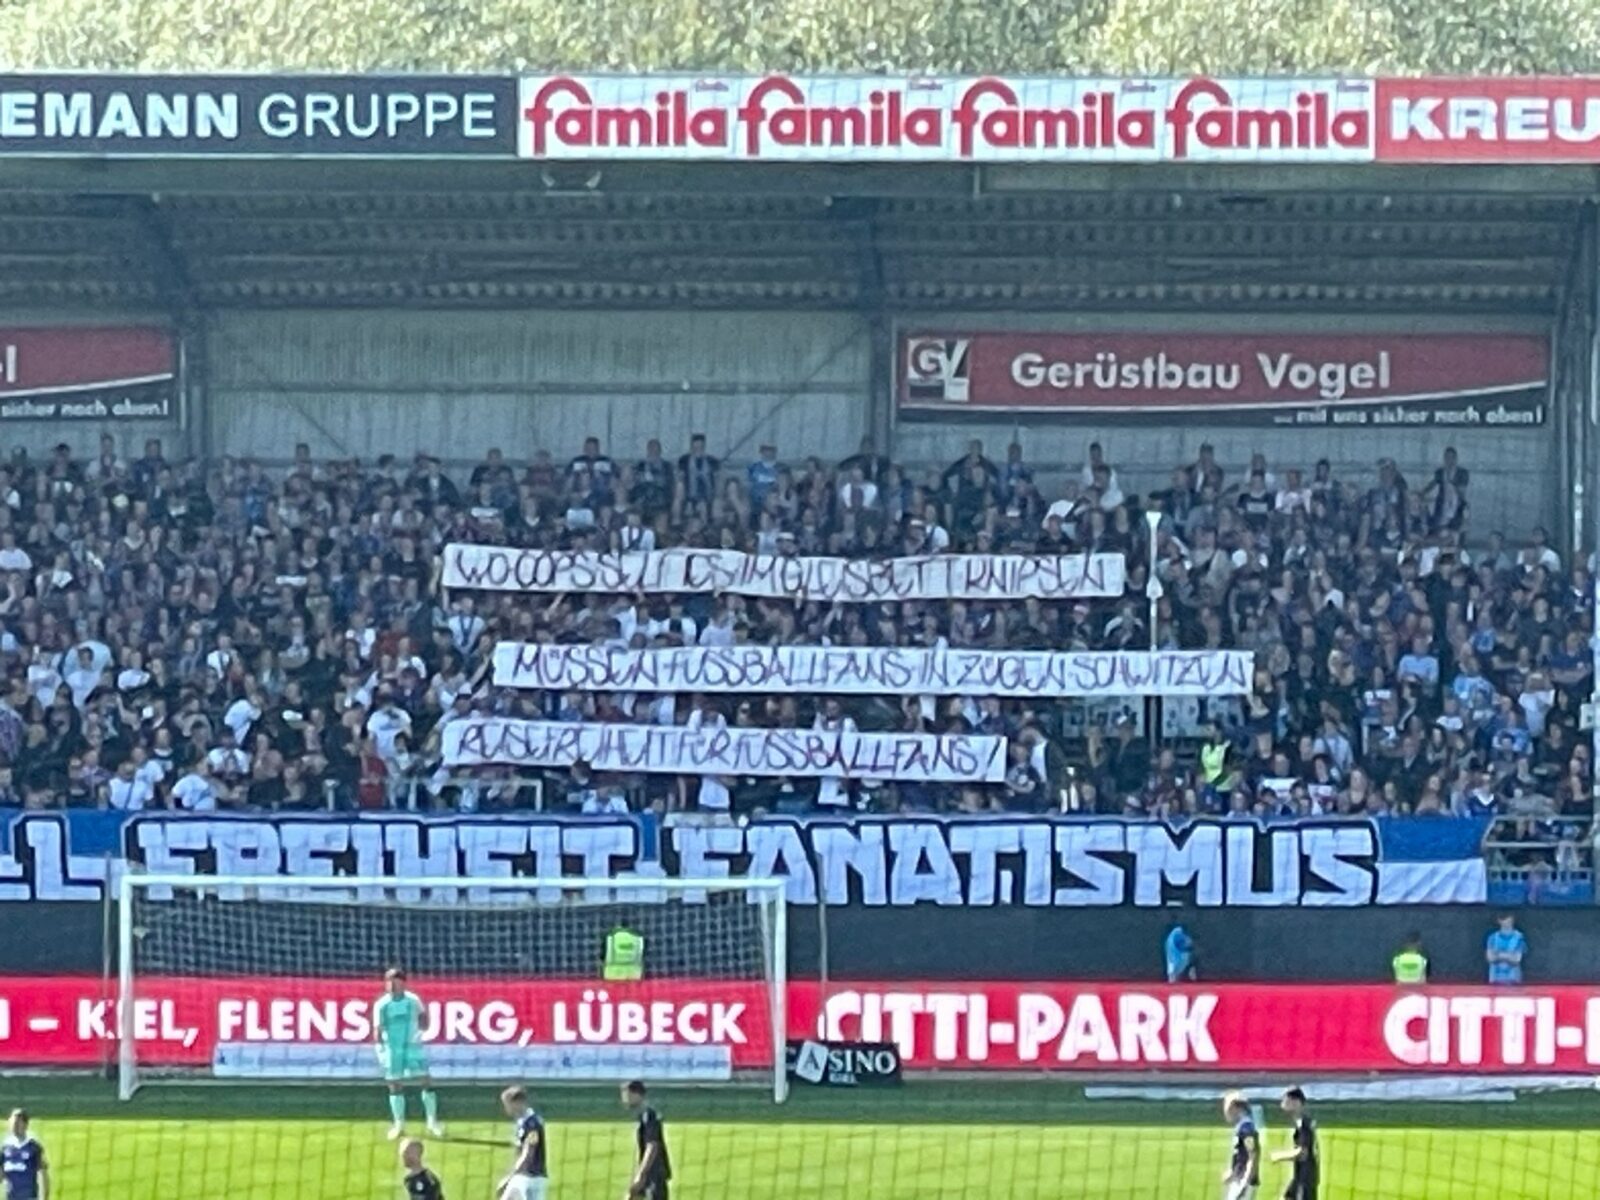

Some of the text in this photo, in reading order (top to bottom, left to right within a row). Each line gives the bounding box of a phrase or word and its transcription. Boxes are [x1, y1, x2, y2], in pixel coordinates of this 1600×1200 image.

[2, 93, 496, 138] EMANN GRUPPE
[525, 76, 727, 156] famila
[738, 76, 942, 156] famila
[952, 78, 1155, 157] famila
[1165, 79, 1369, 158] famila
[1011, 351, 1389, 398] Gerüstbau Vogel
[1373, 405, 1428, 423] sicher
[1435, 405, 1480, 423] nach
[1486, 405, 1542, 423] oben!
[965, 555, 1105, 595] KNIPSEN
[513, 647, 658, 688] MÜSSEN
[667, 648, 911, 688] FUSSBALLFANS
[920, 652, 950, 686] IN
[957, 654, 1065, 691] ZÜGEN
[137, 820, 635, 903] FREIHEIT
[672, 818, 1374, 906] FANATISMUS
[218, 999, 534, 1048] FLENSURG,
[553, 990, 748, 1043] LÜBECK
[818, 991, 1219, 1062] CITTI-PARK
[1384, 994, 1600, 1065] CITTI-
[786, 1042, 897, 1076] ASINO
